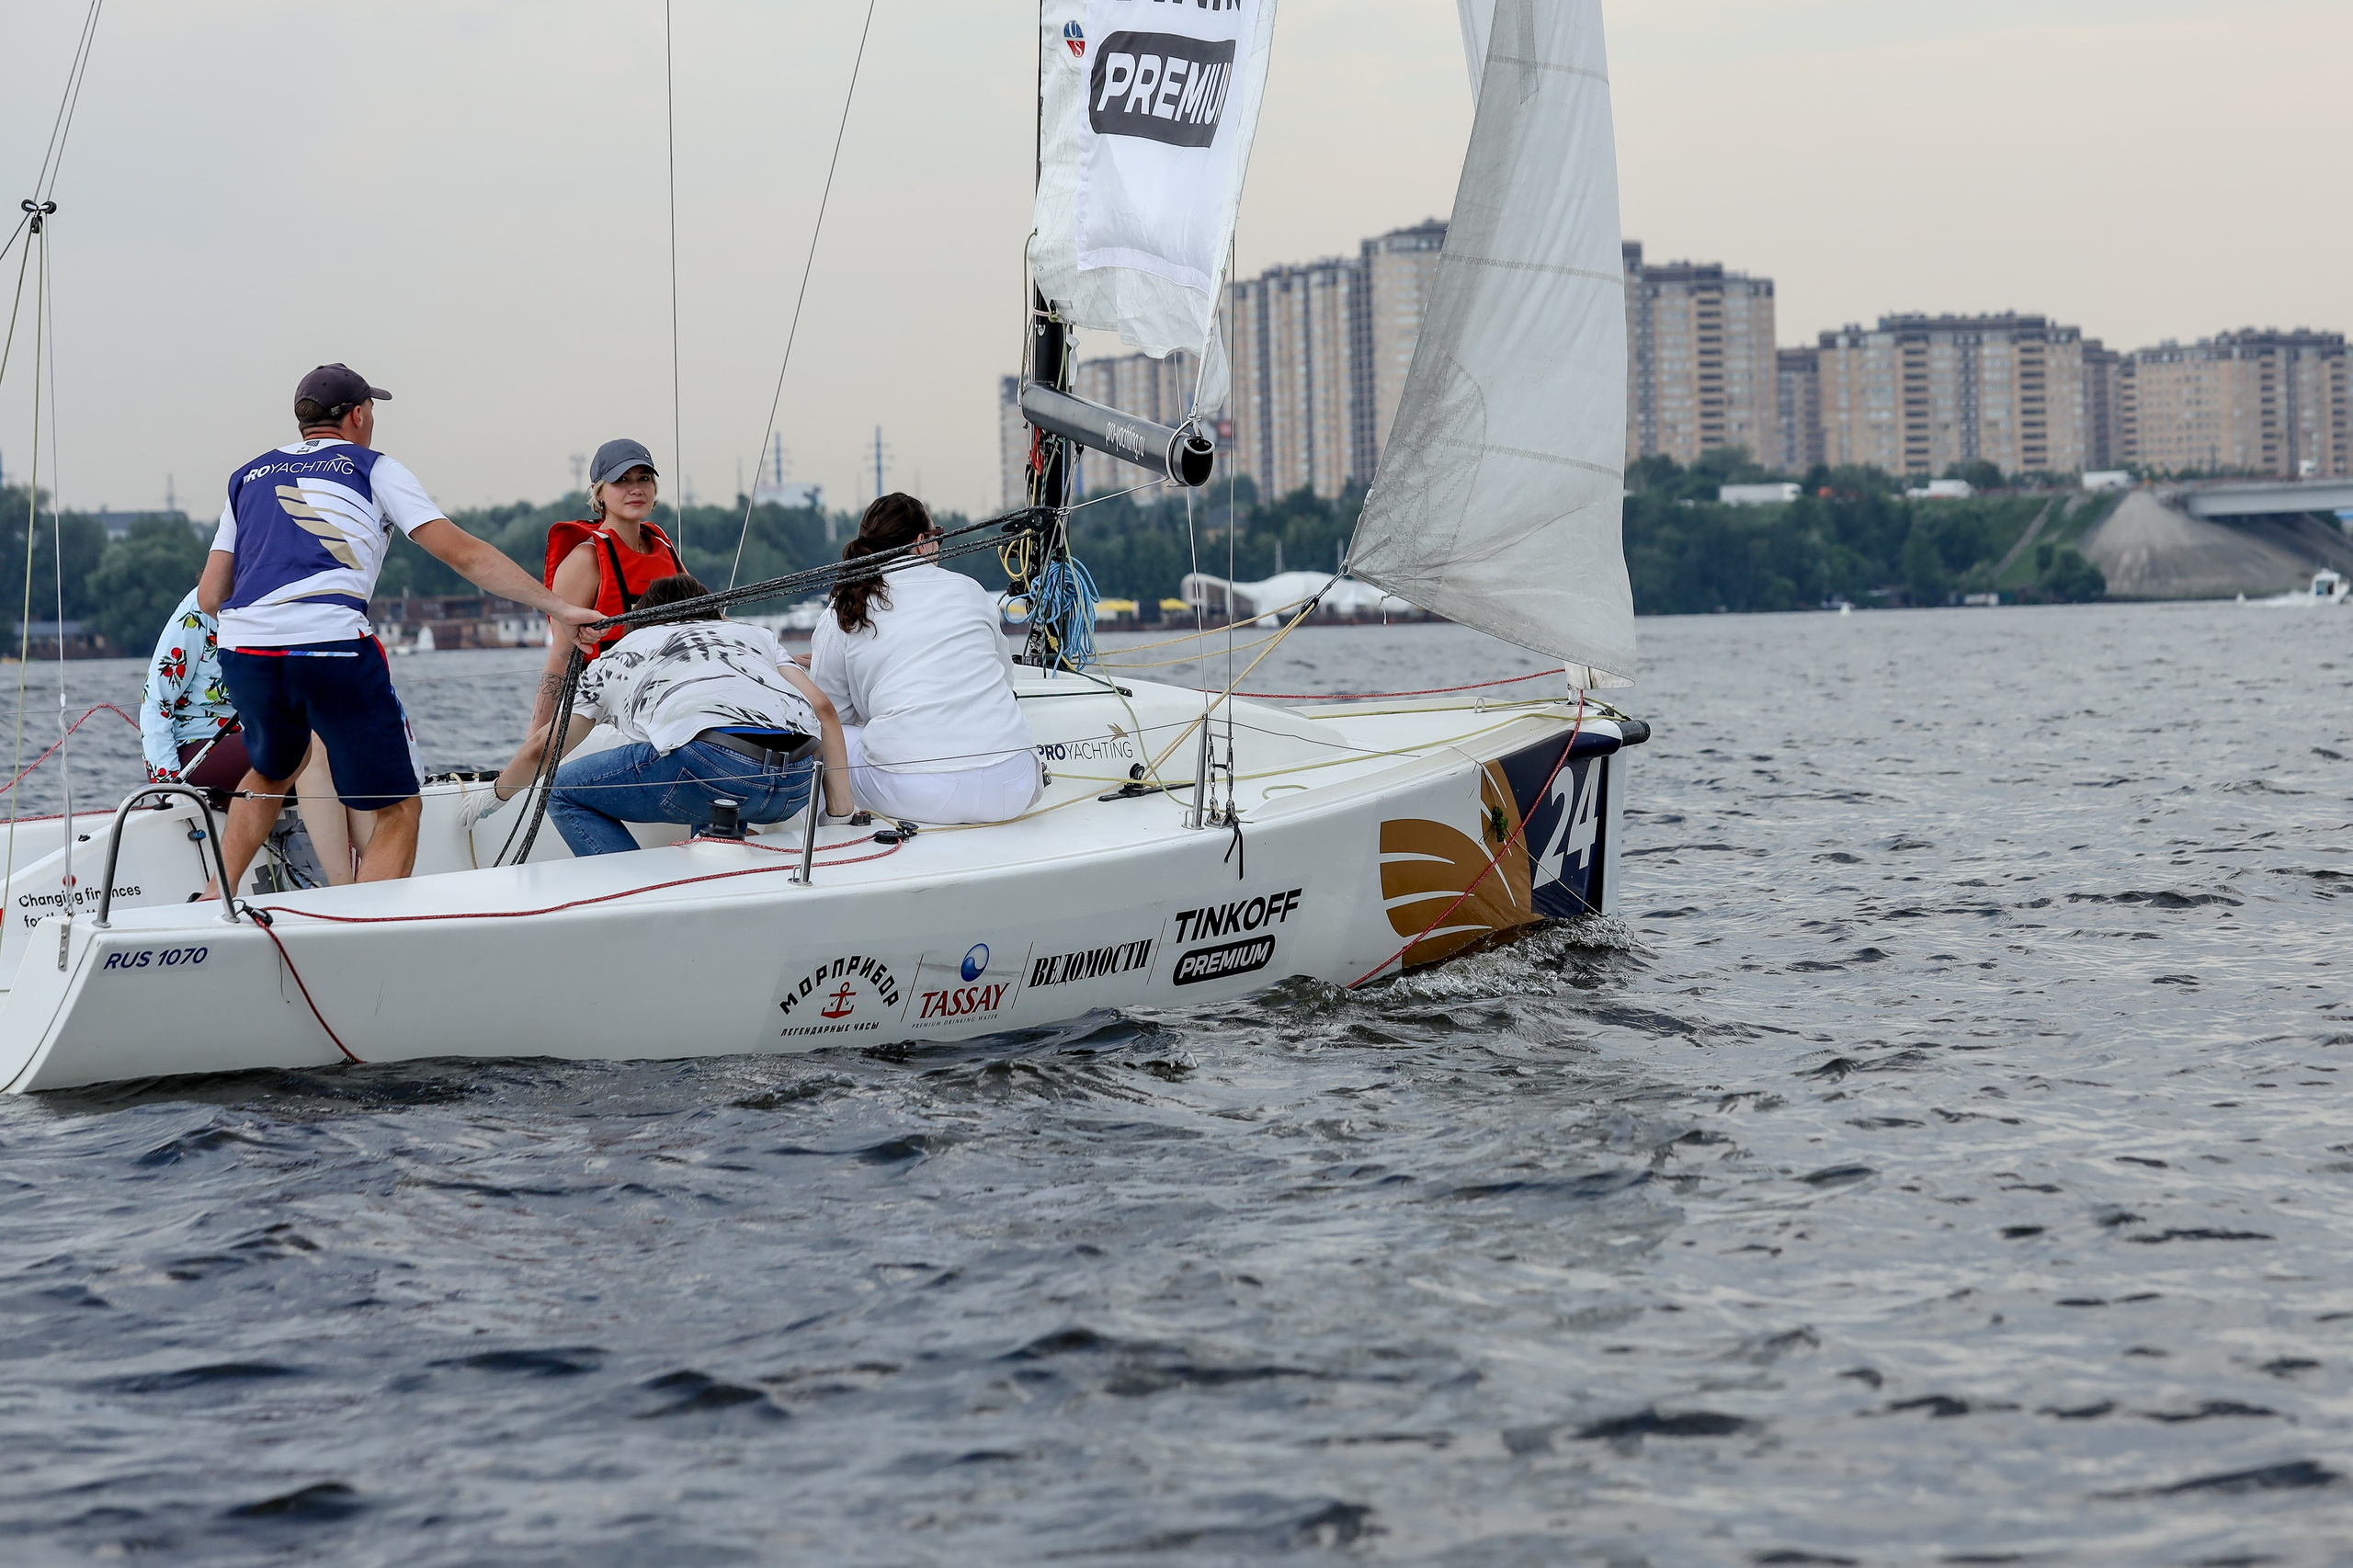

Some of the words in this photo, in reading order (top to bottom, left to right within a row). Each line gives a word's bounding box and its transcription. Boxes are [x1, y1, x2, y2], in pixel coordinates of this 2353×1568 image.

[1532, 756, 1602, 891] 24
[85, 885, 142, 901] finnces
[1175, 888, 1302, 944] TINKOFF
[103, 950, 153, 971] RUS
[157, 947, 209, 967] 1070
[1028, 938, 1154, 989] ВЕДОМОСТИ
[1178, 941, 1271, 980] PREMIUM
[779, 955, 900, 1016] МОРПРИБОР
[919, 983, 1011, 1019] TASSAY
[780, 1023, 850, 1037] ЛЕГЕНДАРНЫЕ
[853, 1021, 880, 1031] ЧАСЫ
[912, 1020, 941, 1029] PREMIUM
[943, 1016, 975, 1026] DRINKING
[978, 1013, 998, 1021] WATER
